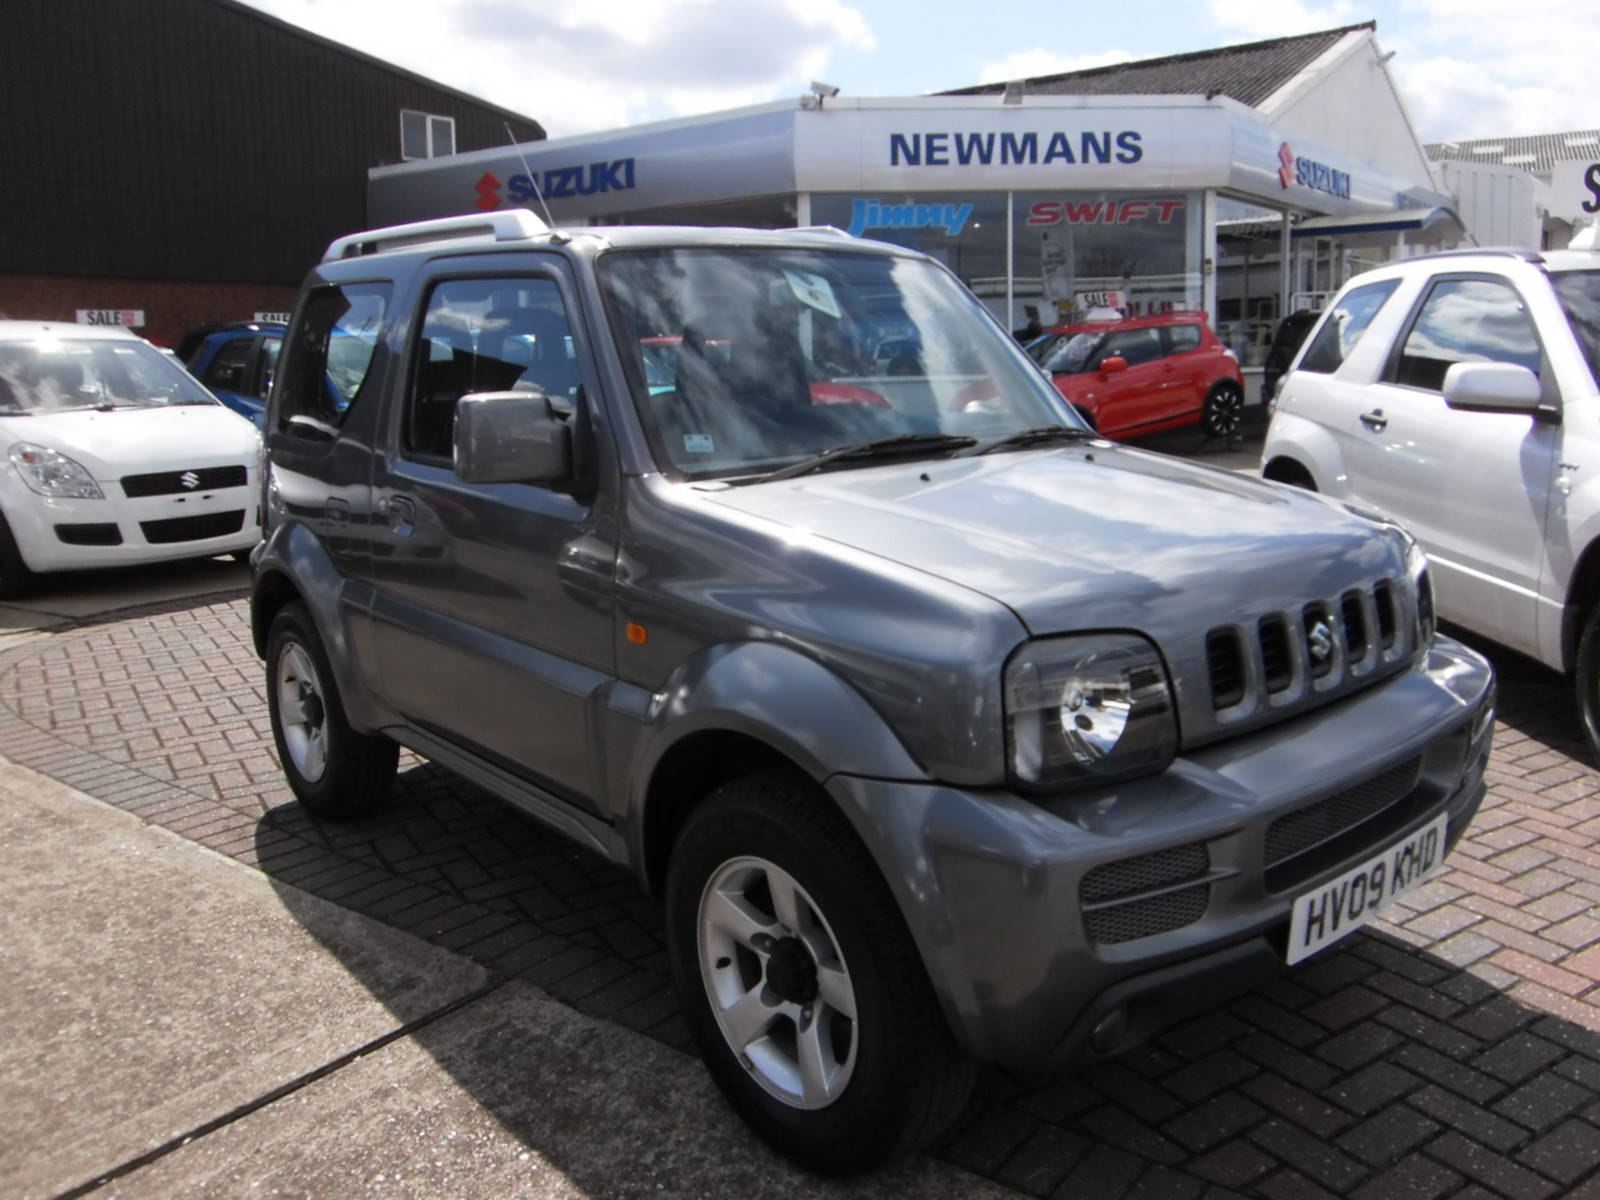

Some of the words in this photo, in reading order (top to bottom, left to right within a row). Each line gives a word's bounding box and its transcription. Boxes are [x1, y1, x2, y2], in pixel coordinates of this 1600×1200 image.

[890, 131, 1144, 166] NEWMANS
[508, 157, 636, 203] SUZUKI
[1296, 156, 1351, 199] SUZUKI
[847, 200, 974, 236] Jimny
[1027, 201, 1184, 224] SWIFT
[1084, 293, 1109, 308] SALE
[87, 311, 121, 326] SALE
[1304, 861, 1387, 947] HV09
[1391, 826, 1438, 896] KHD
